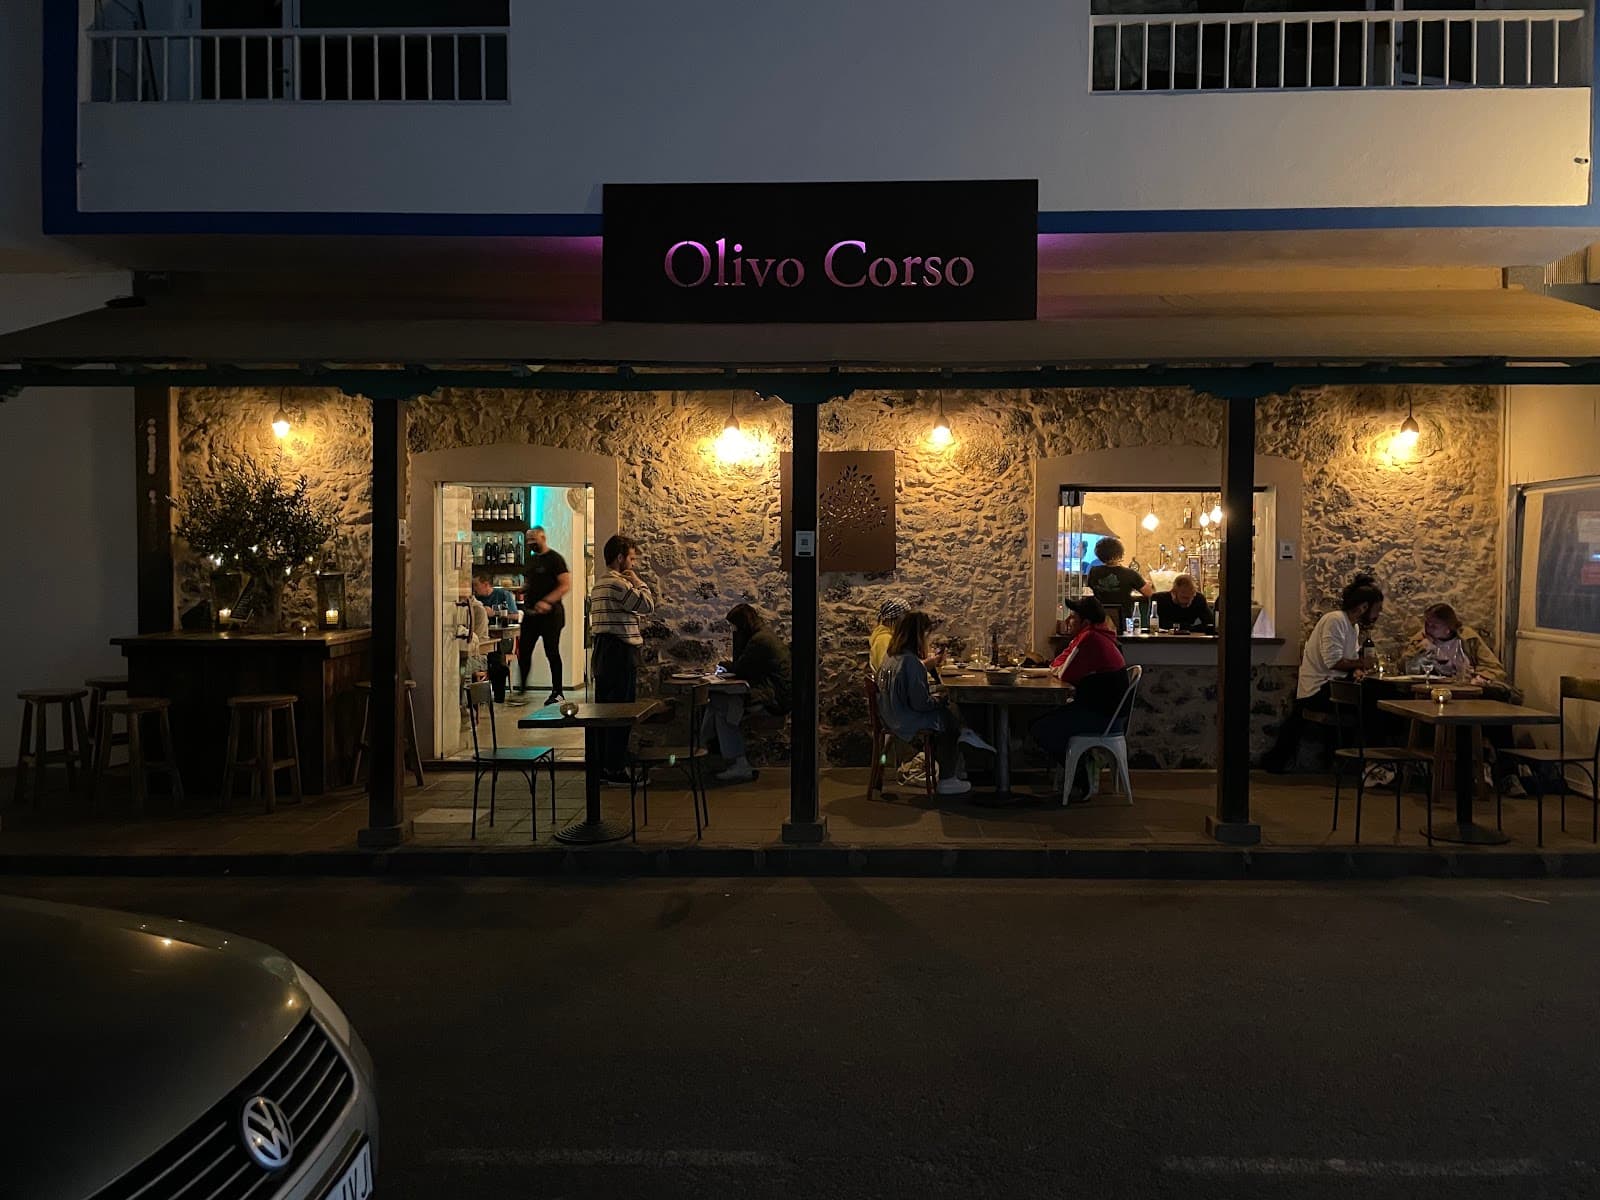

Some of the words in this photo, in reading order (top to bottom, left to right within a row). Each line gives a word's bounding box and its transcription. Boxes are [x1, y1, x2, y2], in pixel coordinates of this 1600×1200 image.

[664, 237, 806, 287] Olivo
[823, 239, 976, 287] Corso
[244, 1097, 293, 1164] VW
